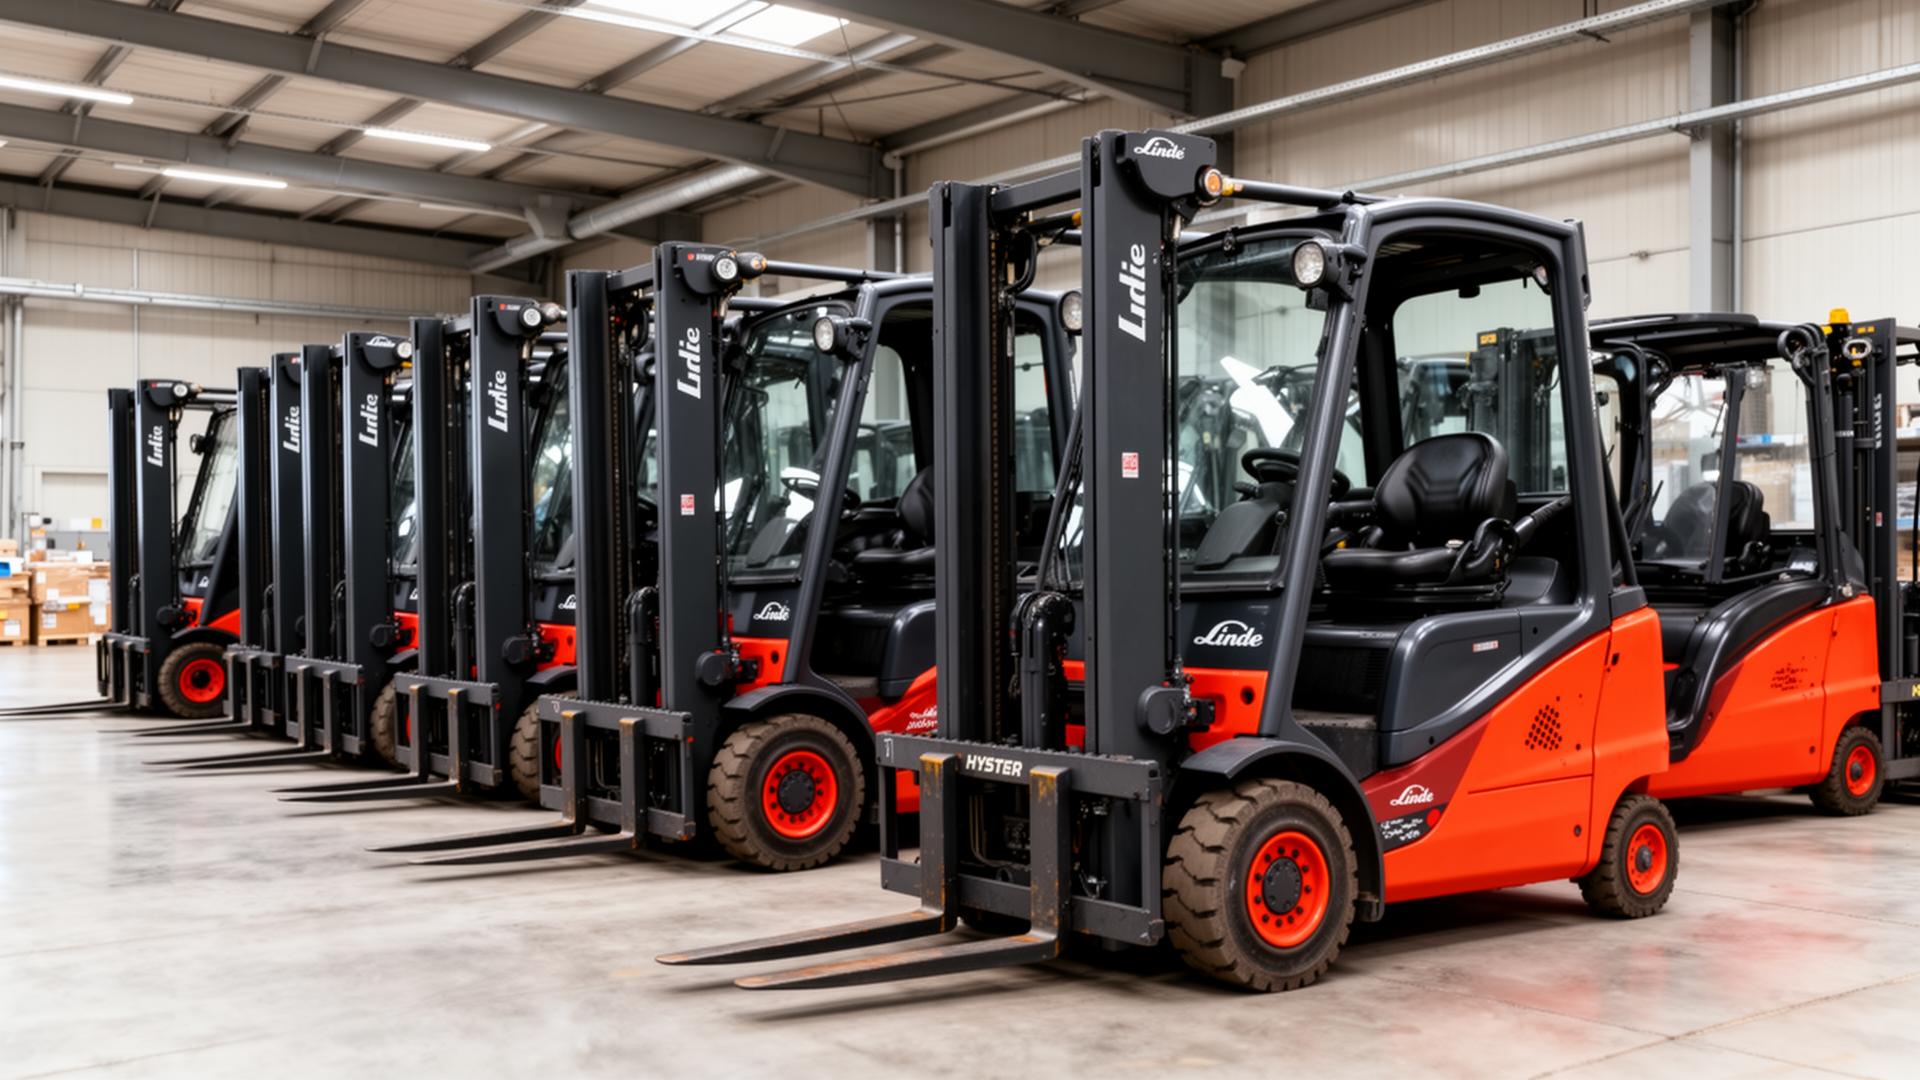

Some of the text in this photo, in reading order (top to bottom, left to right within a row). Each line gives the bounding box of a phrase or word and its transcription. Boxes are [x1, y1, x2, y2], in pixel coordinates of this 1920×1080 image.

[1134, 136, 1186, 160] Linde
[1193, 620, 1264, 648] Linde
[965, 754, 1023, 777] HYSTER
[1390, 784, 1434, 806] Linde
